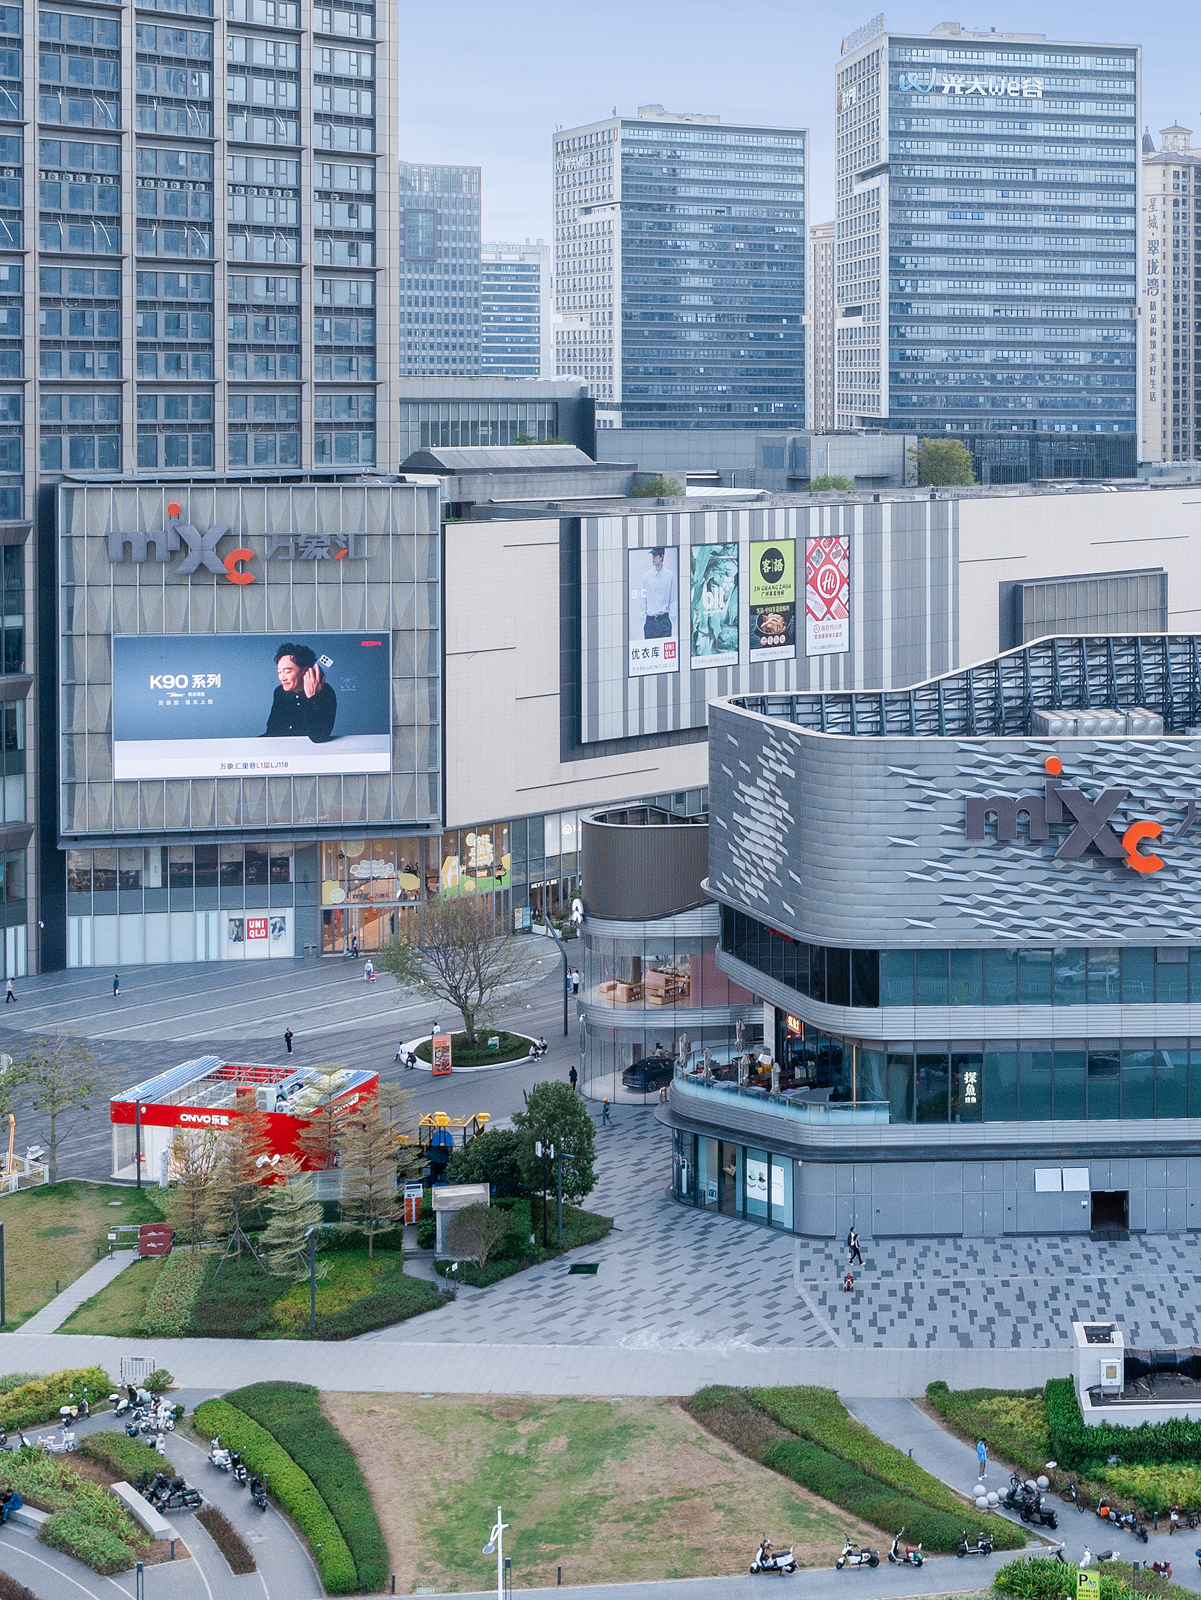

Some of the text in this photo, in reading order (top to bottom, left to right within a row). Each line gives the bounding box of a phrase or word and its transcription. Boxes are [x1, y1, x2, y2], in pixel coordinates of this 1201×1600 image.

[941, 76, 1043, 98] 光大We谷
[263, 532, 371, 560] 万象汇
[822, 571, 836, 592] Hi
[631, 646, 660, 660] 优衣库
[150, 673, 221, 689] K90 系列
[249, 920, 264, 928] UNI
[249, 930, 266, 938] QLO
[1079, 1574, 1088, 1586] P
